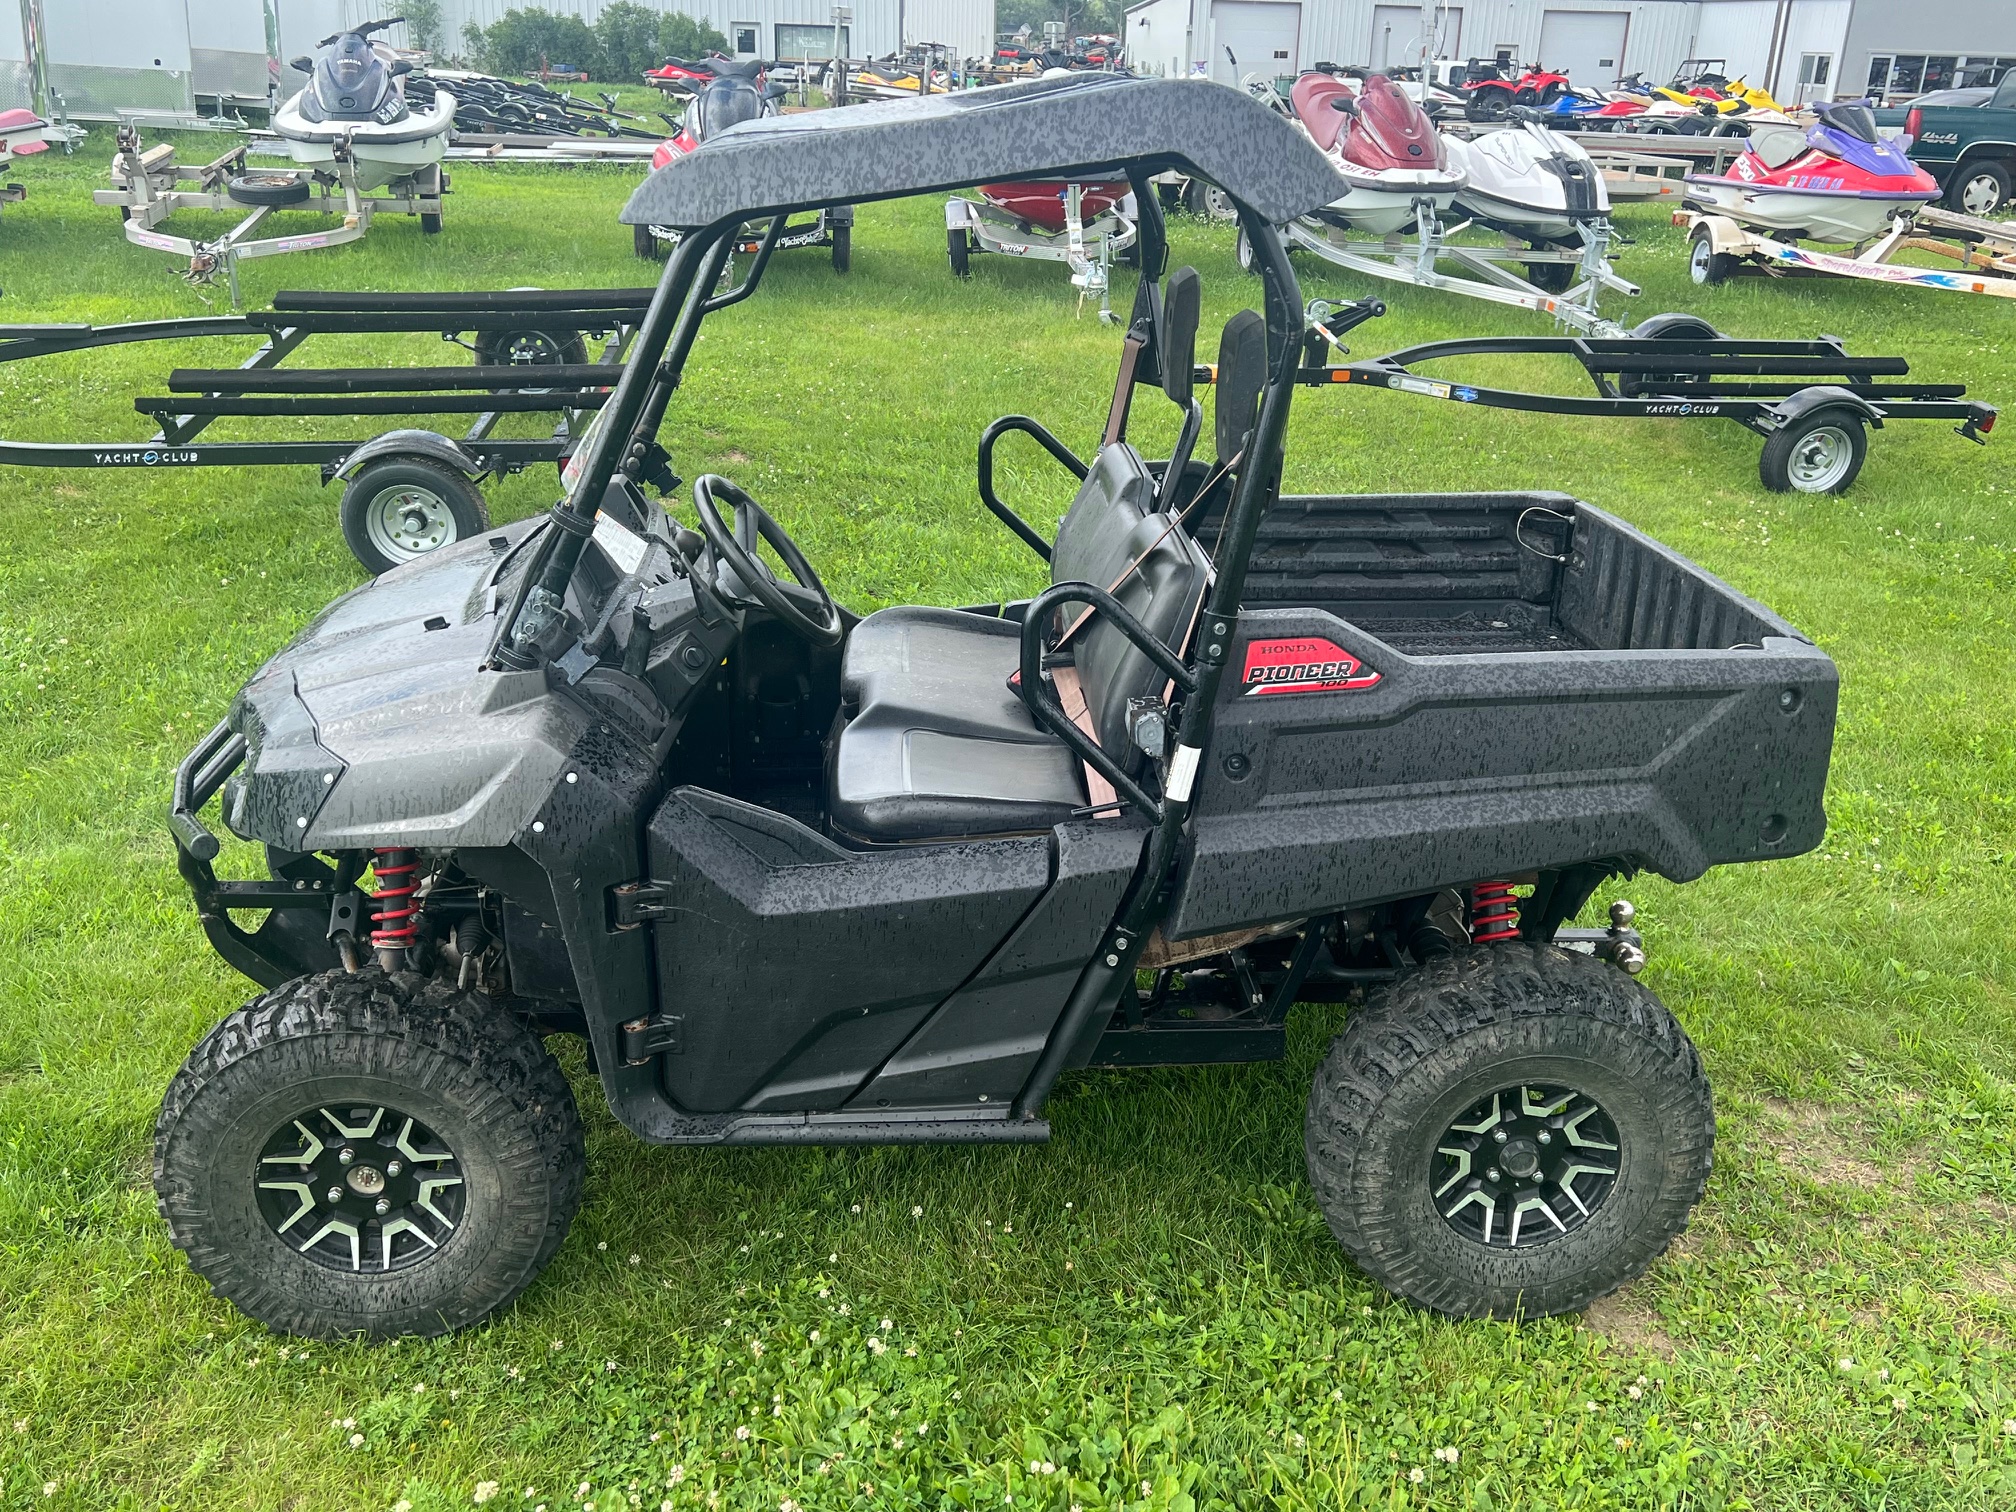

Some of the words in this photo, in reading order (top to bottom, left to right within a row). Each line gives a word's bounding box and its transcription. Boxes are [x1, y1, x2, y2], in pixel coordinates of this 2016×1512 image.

[336, 58, 362, 66] YAMAHA
[1920, 131, 1959, 145] 4x4
[1000, 242, 1026, 253] TRITON
[1645, 405, 1680, 414] YACHT
[1693, 405, 1720, 414] CLUB
[94, 453, 140, 464] YACHT
[162, 452, 199, 462] CLUB
[1261, 644, 1318, 655] HONDA
[1247, 660, 1353, 683] PIONEER
[1316, 679, 1349, 688] 700
